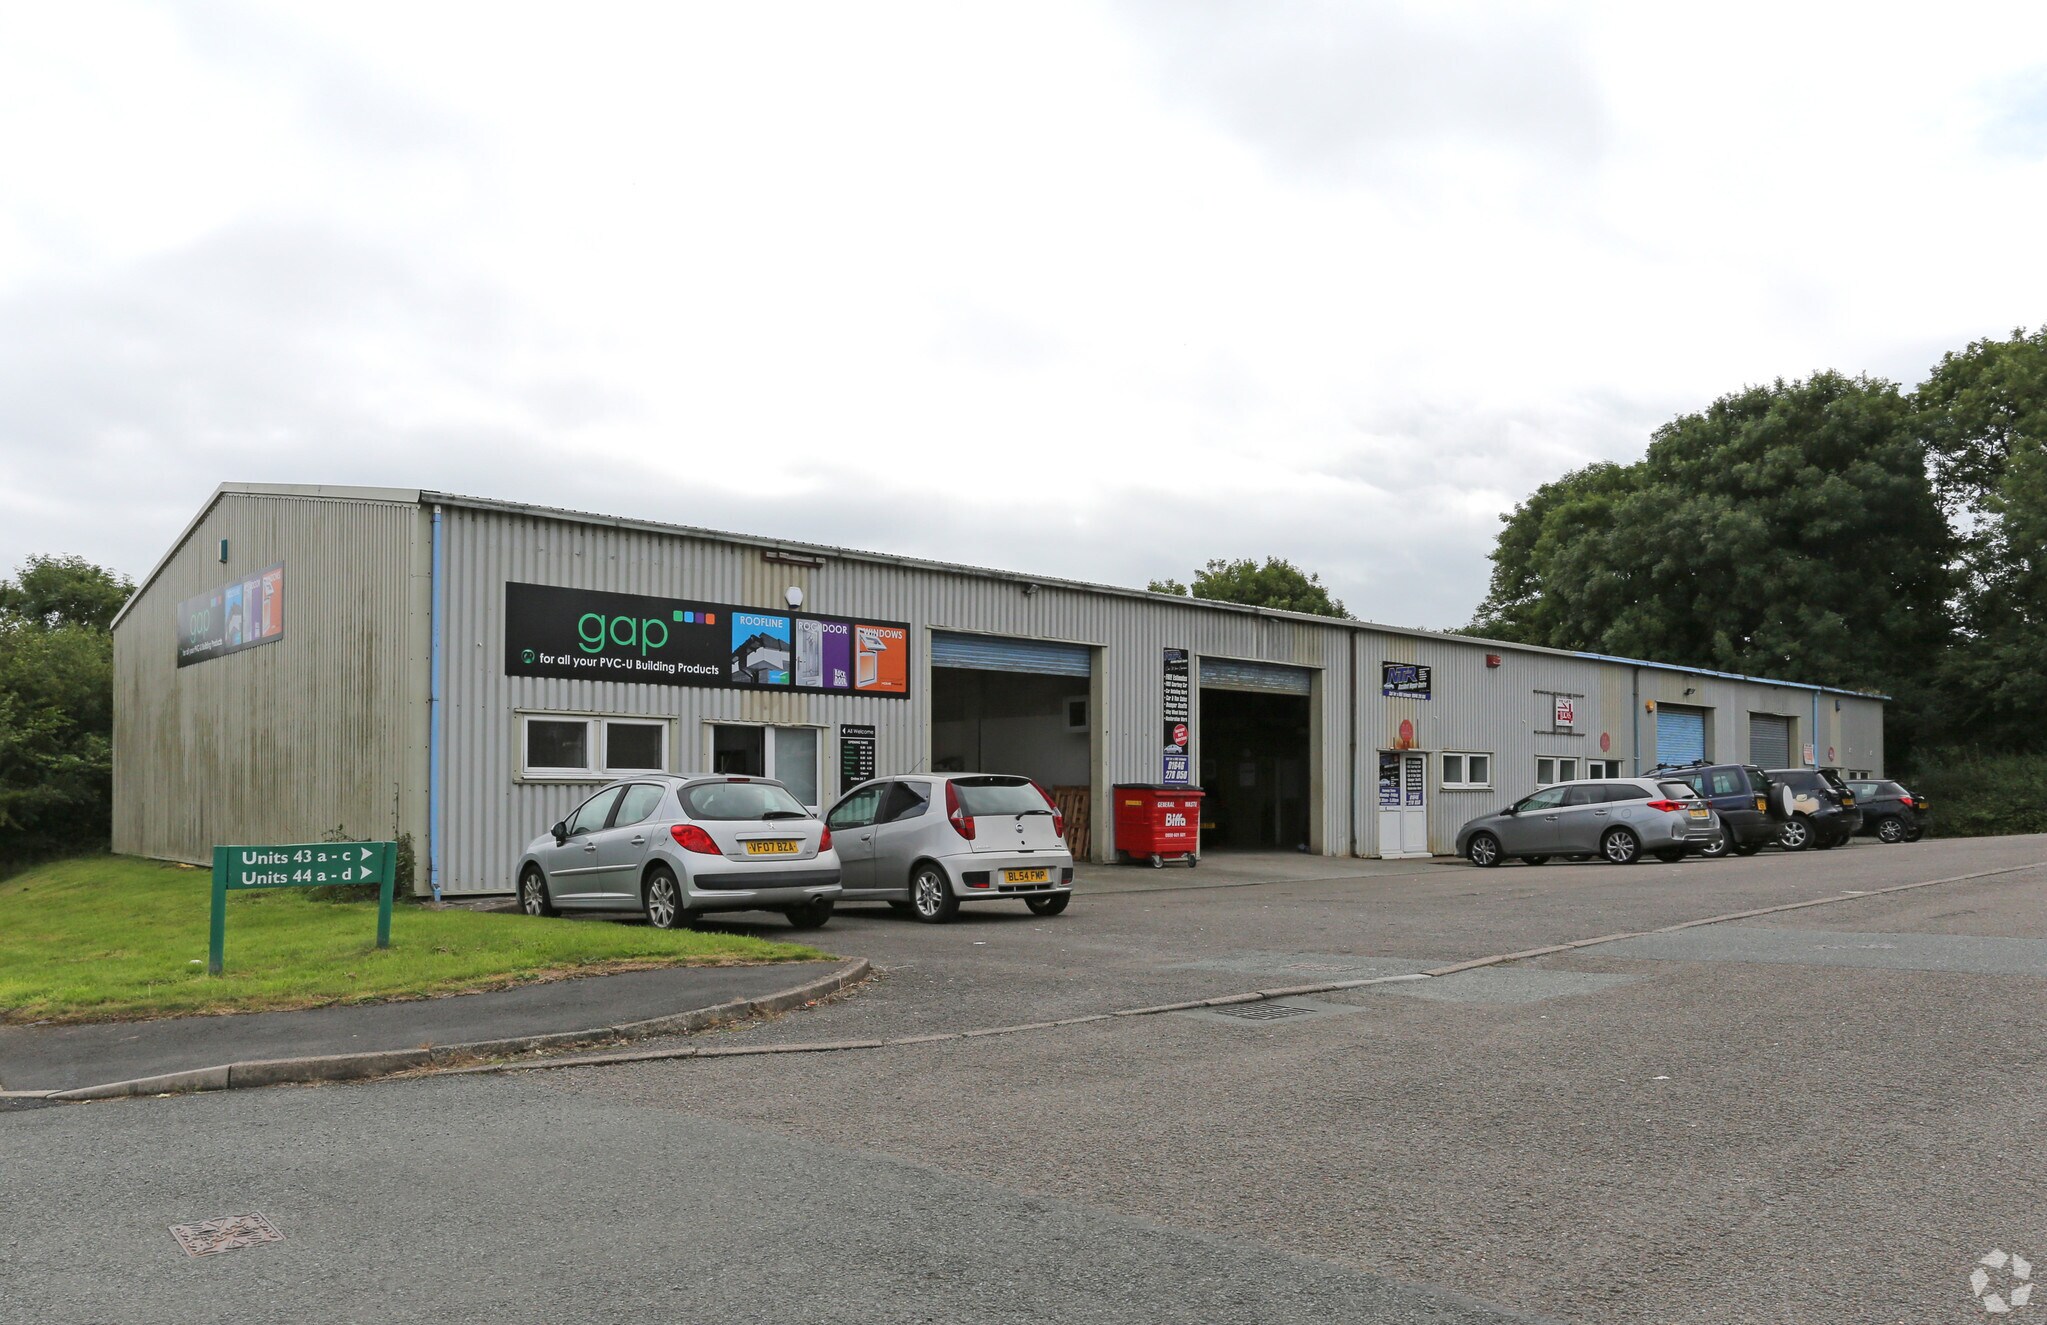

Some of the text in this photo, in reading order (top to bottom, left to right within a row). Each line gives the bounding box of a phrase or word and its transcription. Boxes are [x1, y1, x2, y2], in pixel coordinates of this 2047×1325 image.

[189, 609, 210, 643] gap
[740, 616, 783, 629] ROOFLINE
[577, 613, 669, 657] gap
[863, 628, 903, 640] WINDOWS
[539, 653, 719, 675] for all your PVC-U Building Products
[1387, 666, 1418, 684] NTR
[1165, 813, 1186, 827] Biffa
[750, 842, 794, 852] VF07 BZA
[242, 851, 288, 865] Units
[293, 850, 312, 863] 43
[317, 852, 327, 862] a
[342, 851, 351, 861] c
[242, 871, 288, 885] Units
[292, 869, 312, 882] 44
[316, 872, 327, 881] a
[341, 867, 352, 880] d
[1008, 871, 1029, 881] BL54
